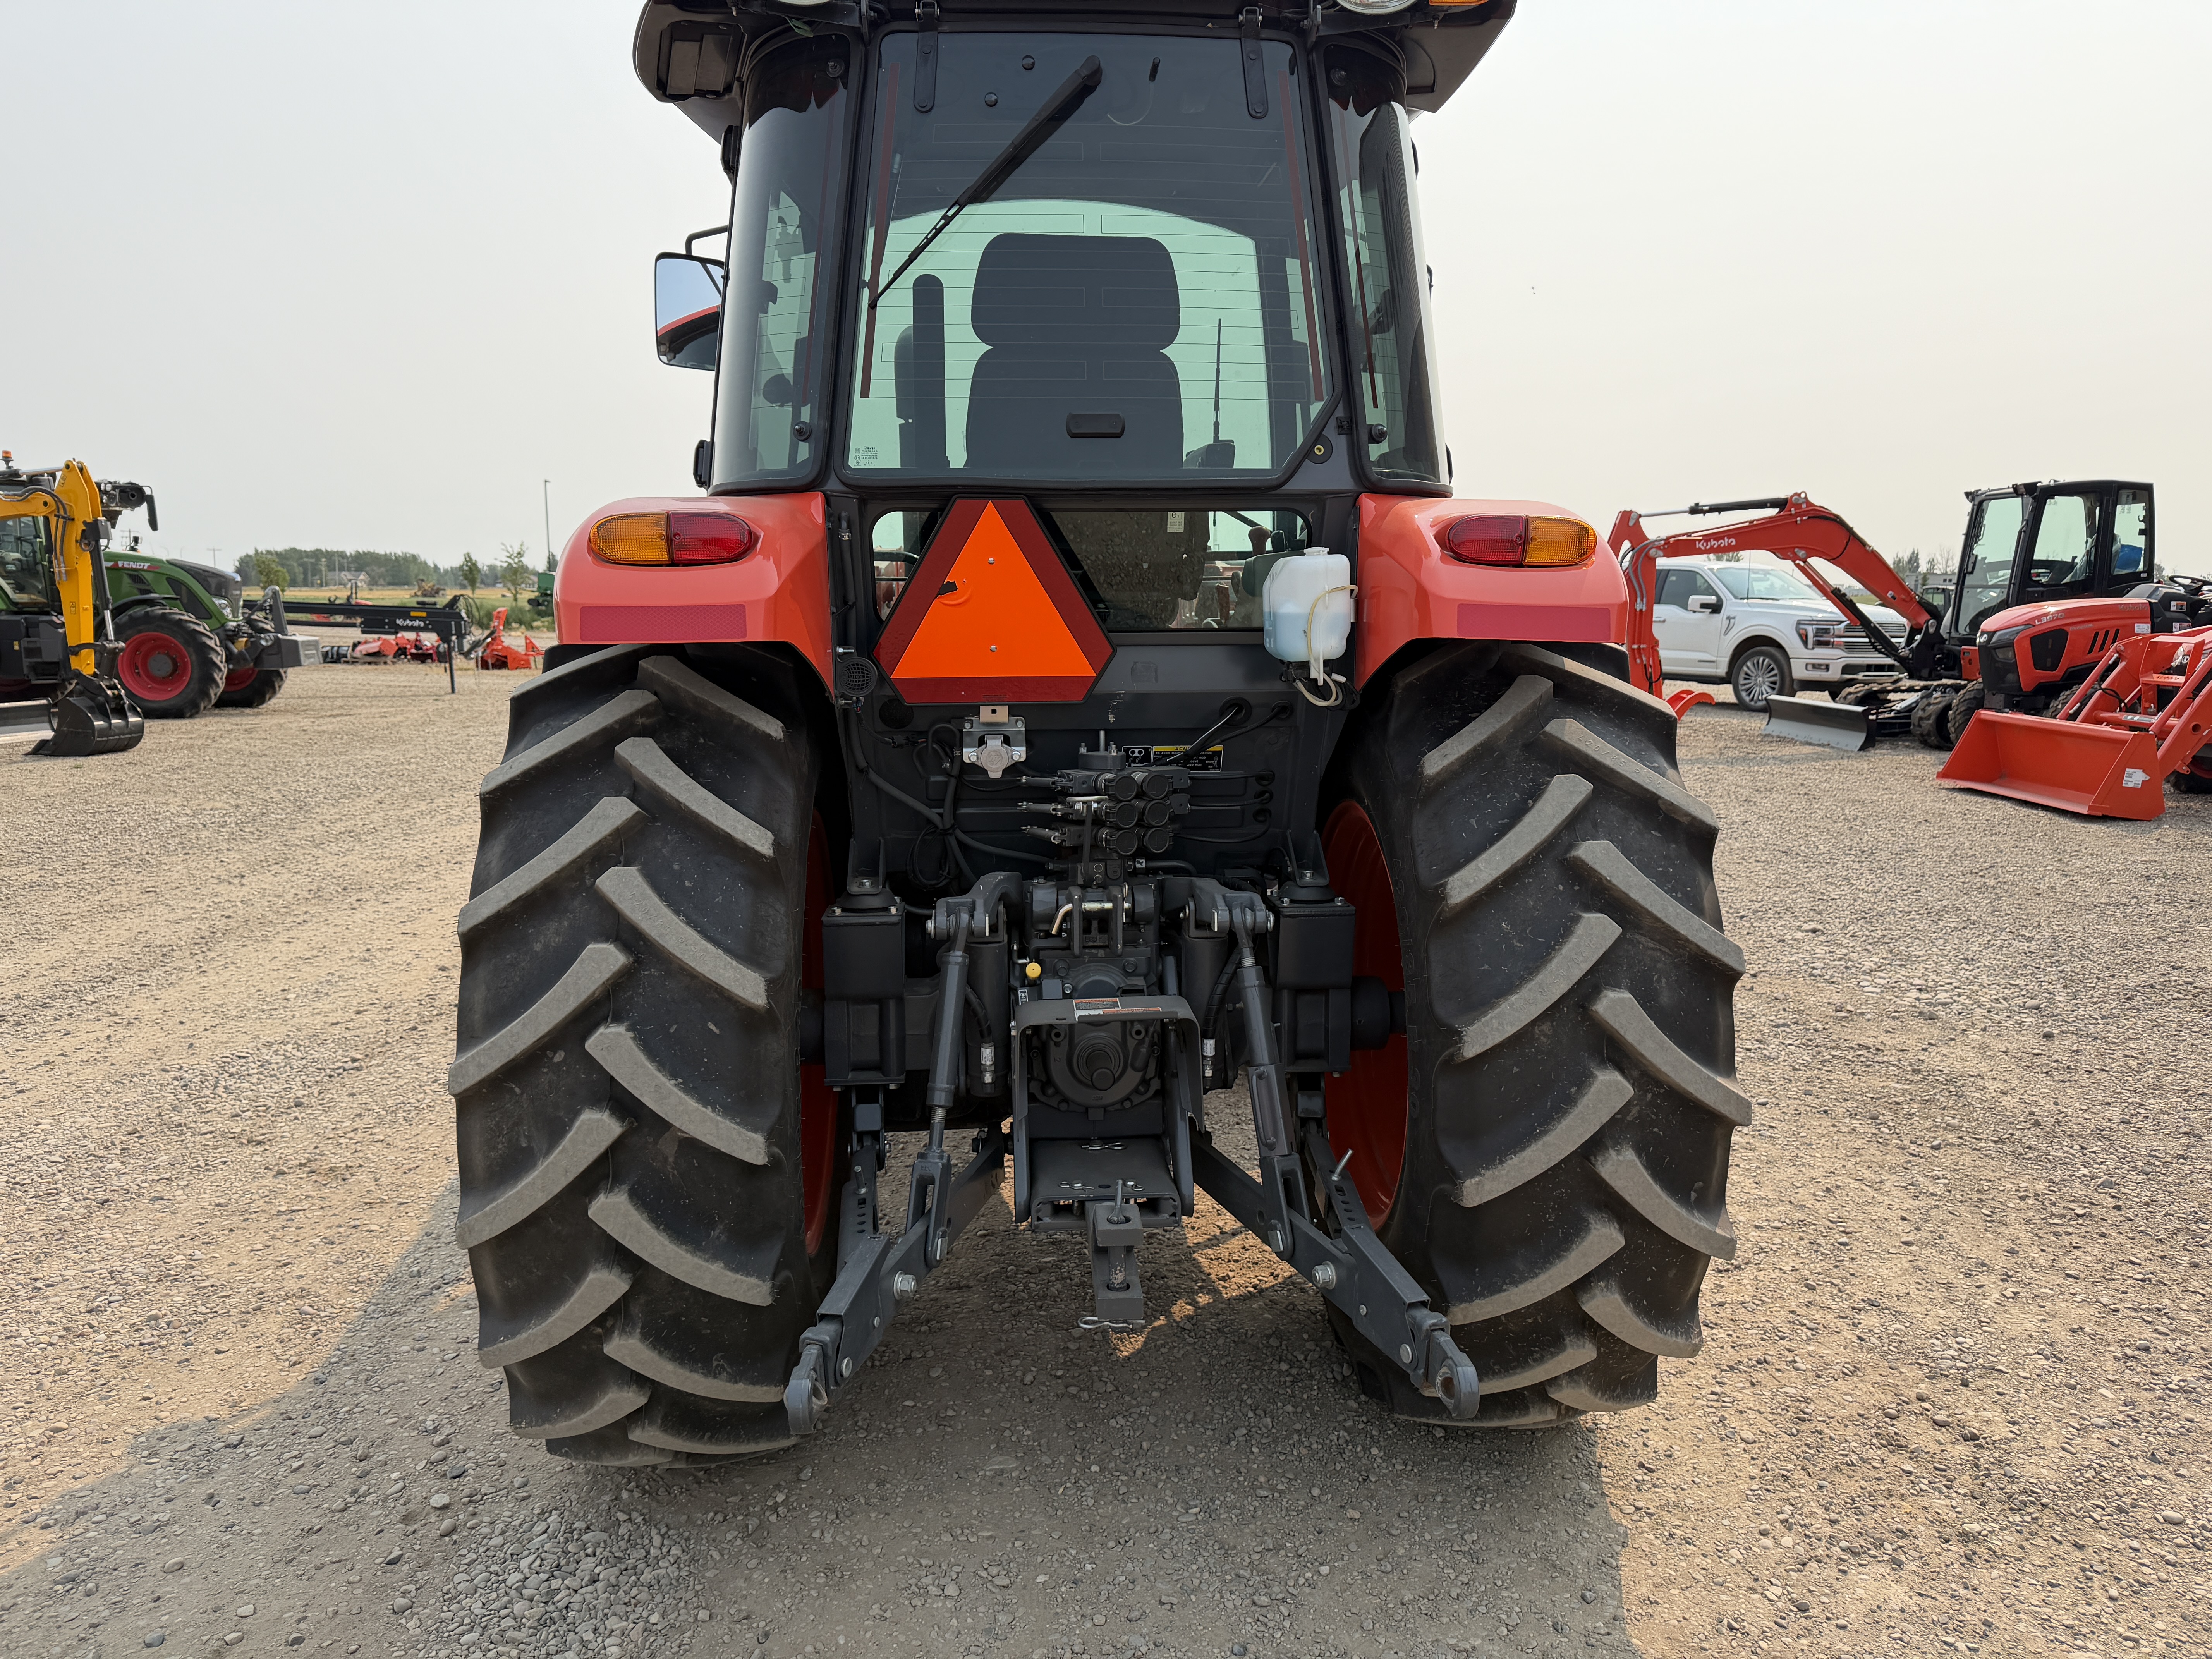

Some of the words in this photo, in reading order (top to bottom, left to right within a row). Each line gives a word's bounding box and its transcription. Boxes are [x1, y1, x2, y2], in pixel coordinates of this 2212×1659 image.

[1696, 536, 1736, 550] Kubota
[118, 561, 150, 569] FENDT
[396, 618, 424, 627] Kubota
